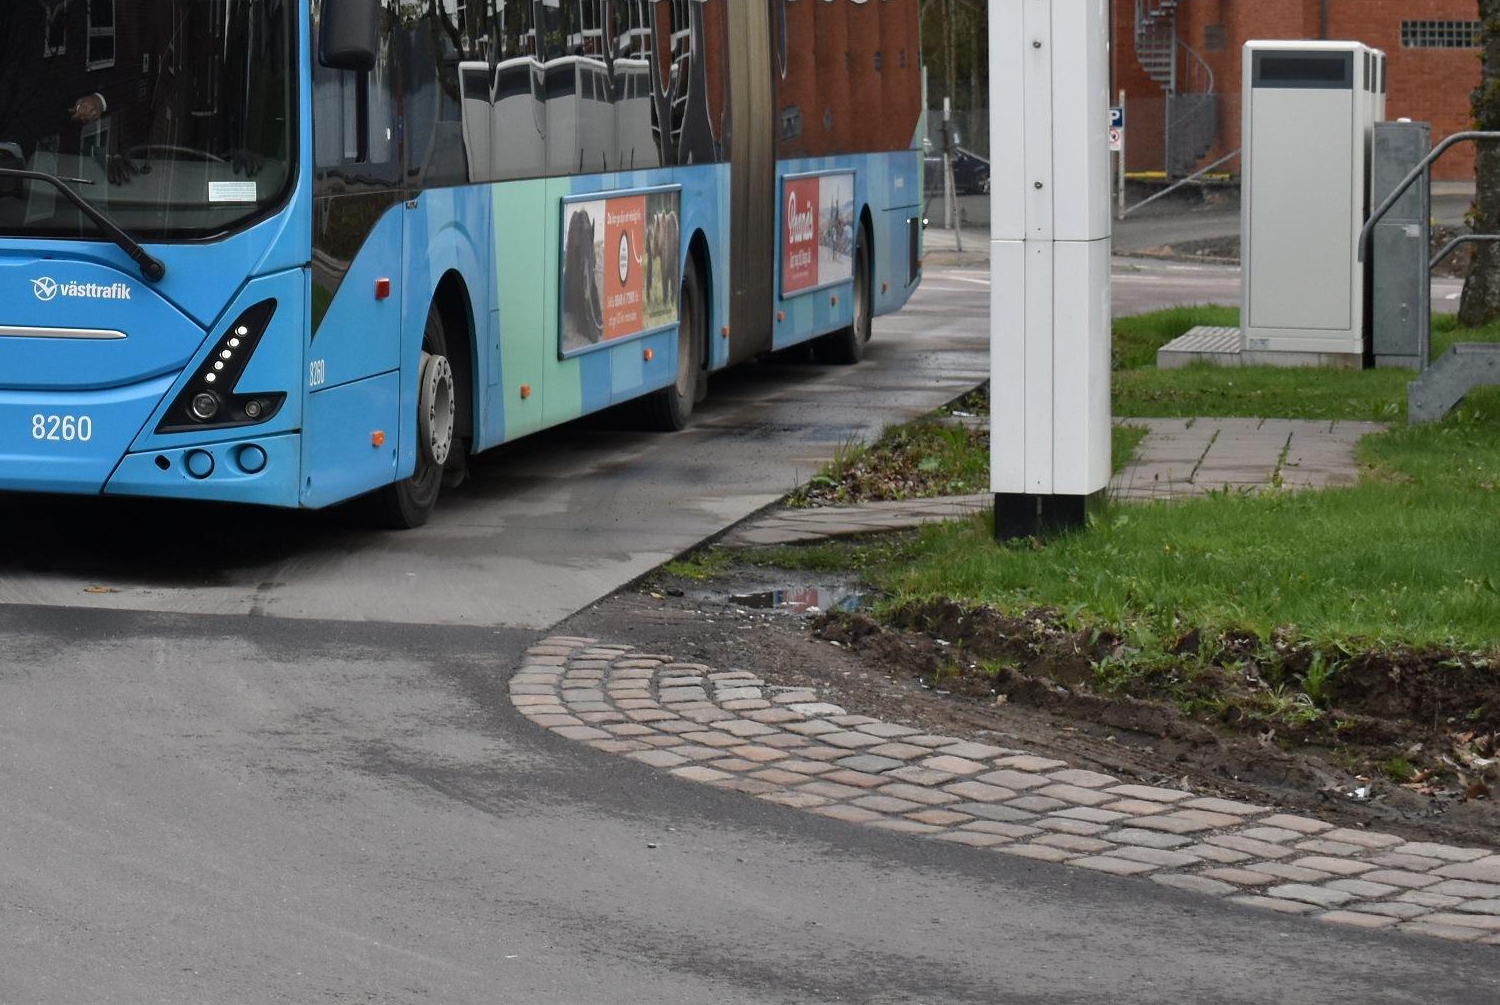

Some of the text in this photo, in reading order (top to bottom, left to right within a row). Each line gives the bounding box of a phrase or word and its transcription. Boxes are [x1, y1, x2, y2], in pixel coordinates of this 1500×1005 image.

[1110, 109, 1120, 126] P
[60, 281, 131, 299] västtrafik
[309, 359, 325, 387] 8260
[31, 414, 93, 441] 8260
